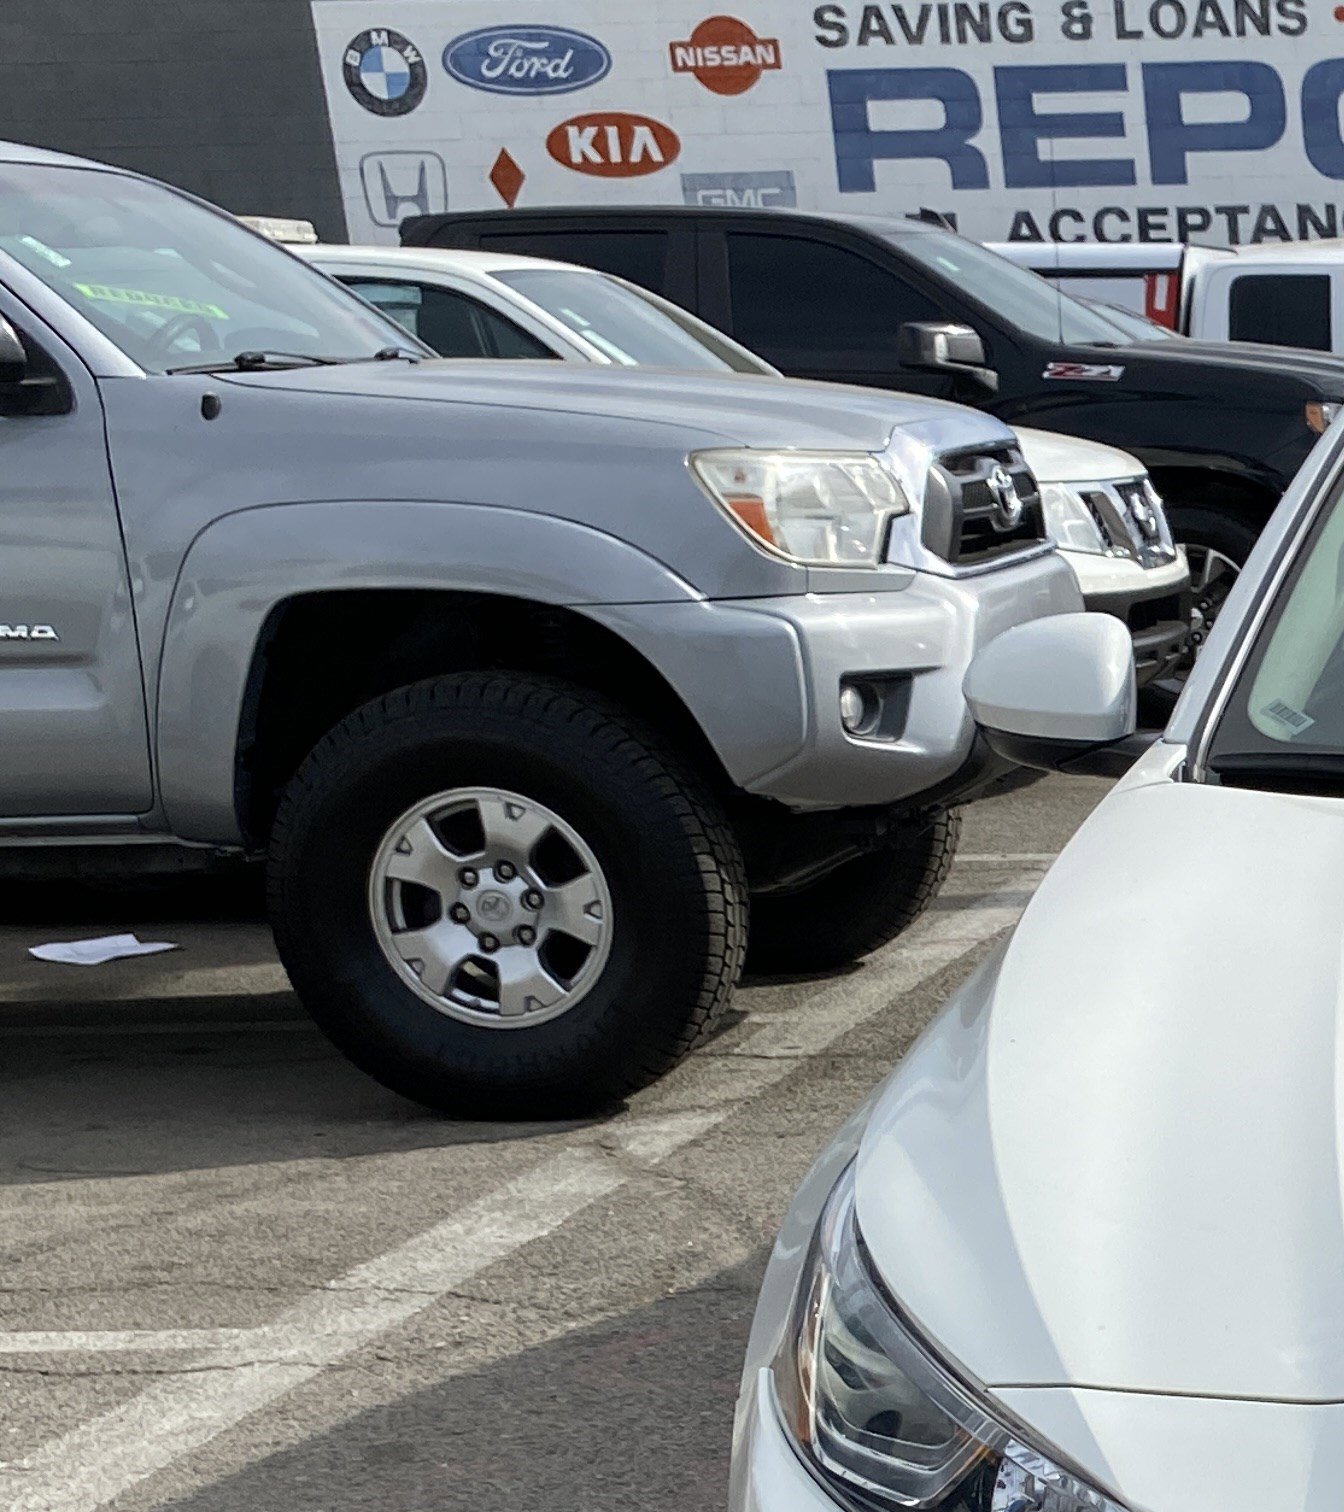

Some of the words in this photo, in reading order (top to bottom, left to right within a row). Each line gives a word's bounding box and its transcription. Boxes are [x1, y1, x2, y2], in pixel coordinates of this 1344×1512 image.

[814, 2, 1033, 47] SAVING
[1061, 0, 1093, 40] &
[1115, 0, 1308, 40] LOANS
[481, 38, 573, 80] Ford
[675, 44, 775, 67] NISSAN
[566, 125, 664, 164] KIA
